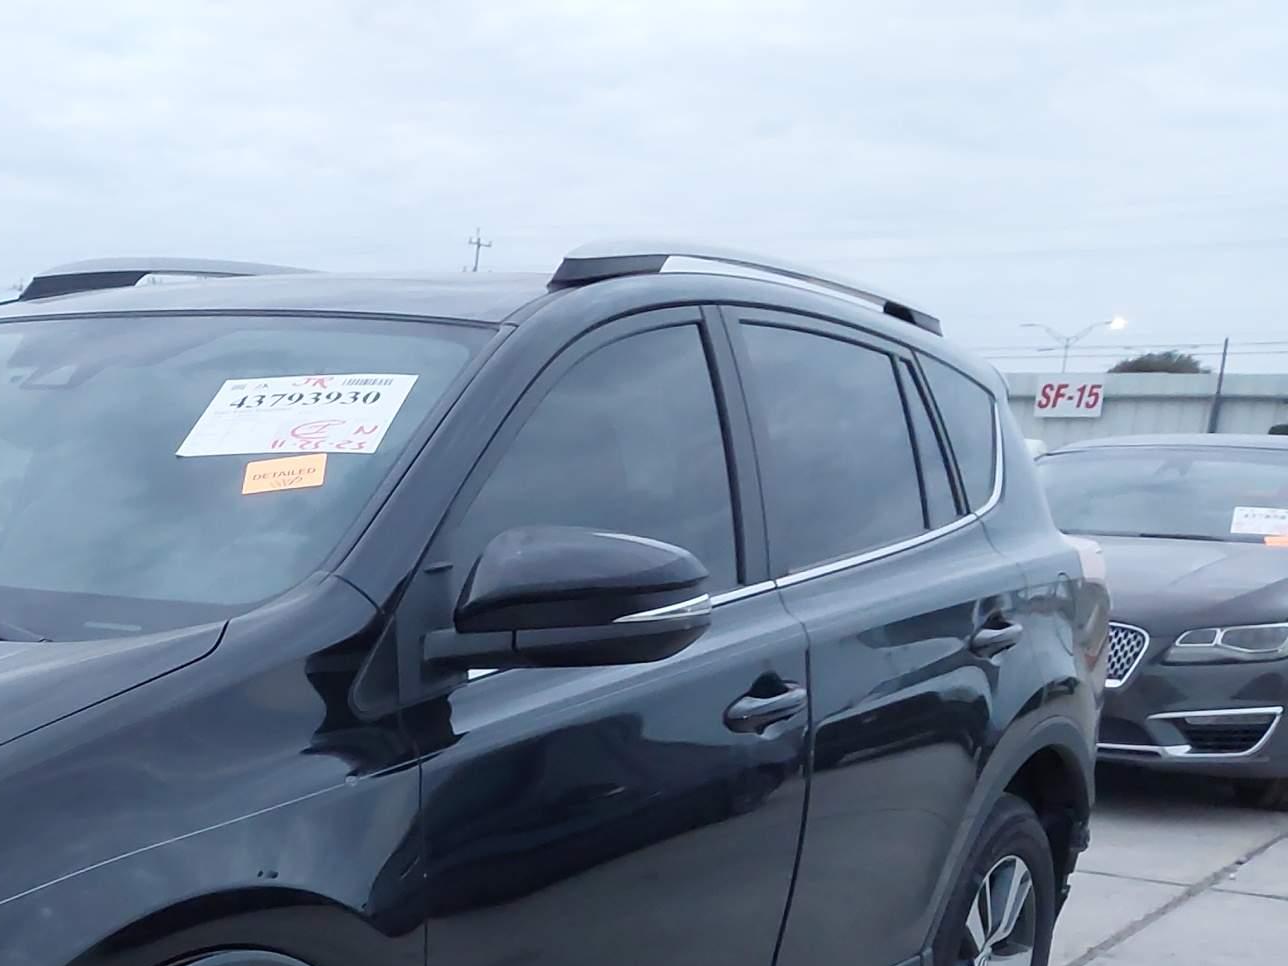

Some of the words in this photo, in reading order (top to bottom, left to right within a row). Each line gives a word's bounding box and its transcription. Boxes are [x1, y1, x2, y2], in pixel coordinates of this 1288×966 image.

[230, 390, 382, 408] 43793930
[1037, 383, 1102, 409] SF-15
[252, 467, 317, 481] DETAILED
